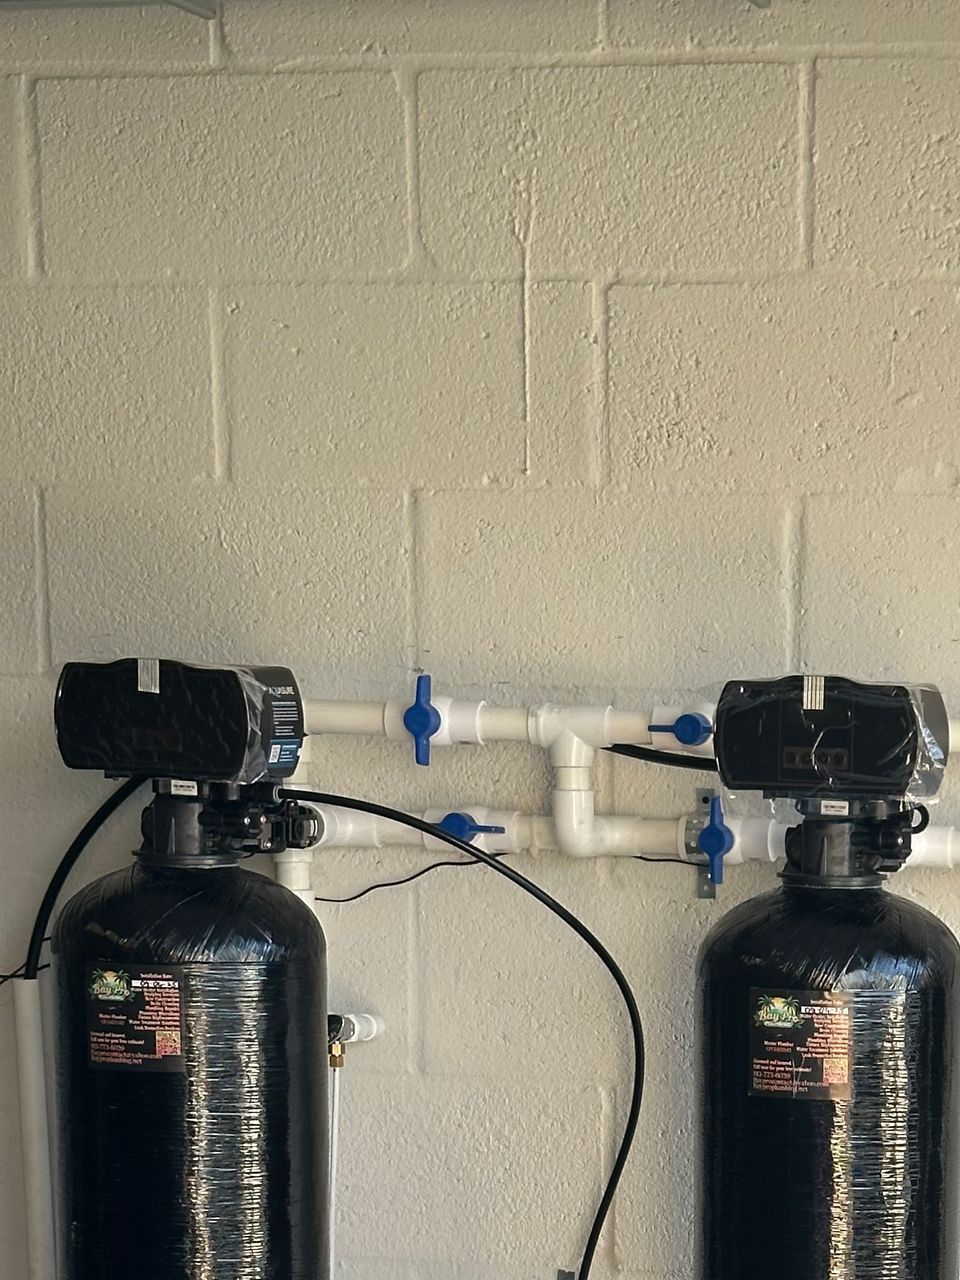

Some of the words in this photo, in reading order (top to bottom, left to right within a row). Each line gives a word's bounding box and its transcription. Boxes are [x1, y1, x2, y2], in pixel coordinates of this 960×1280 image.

[93, 983, 112, 997] Bay
[758, 1008, 780, 1023] Bay
[782, 1010, 799, 1024] Pro
